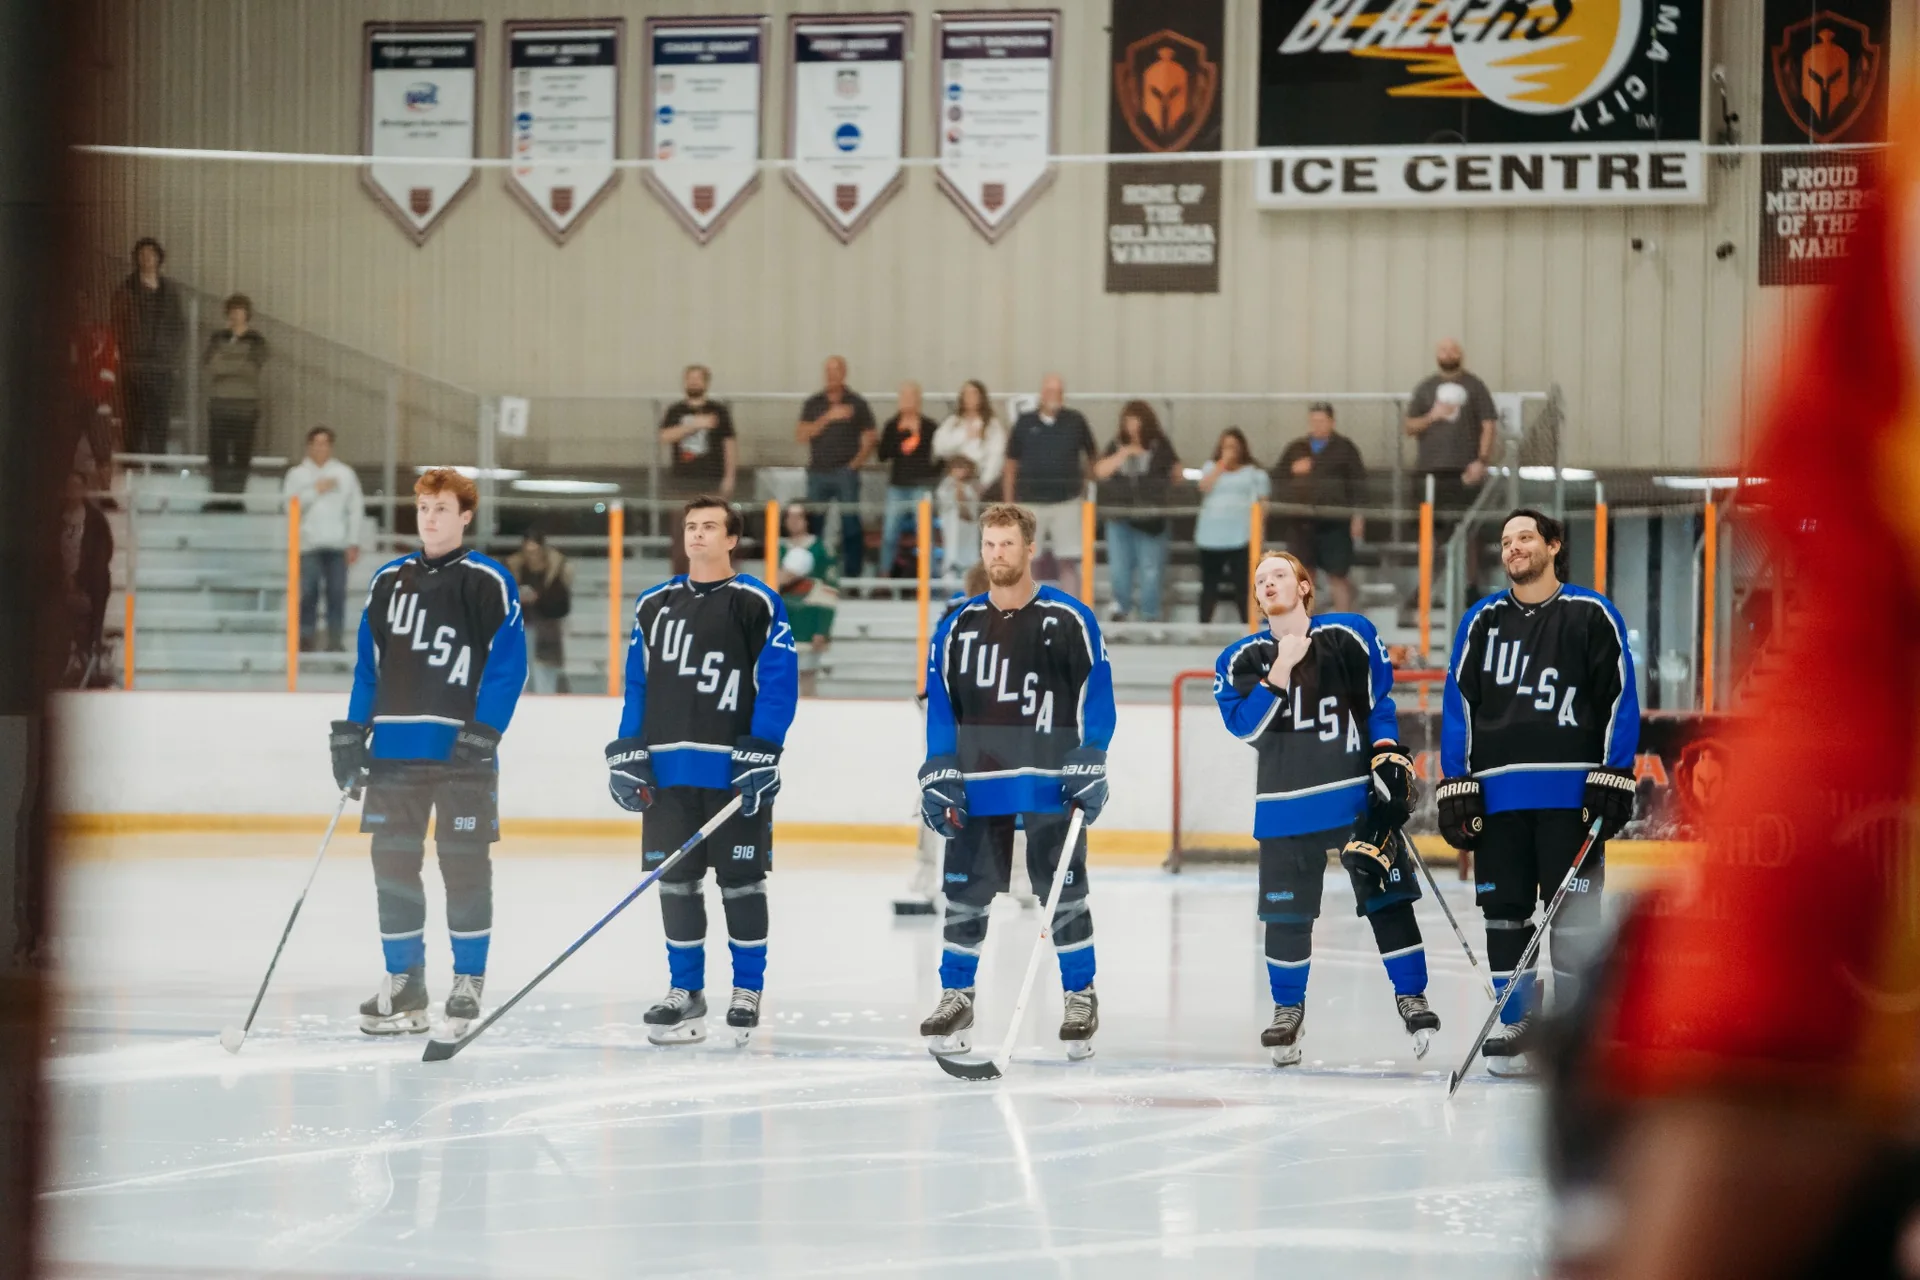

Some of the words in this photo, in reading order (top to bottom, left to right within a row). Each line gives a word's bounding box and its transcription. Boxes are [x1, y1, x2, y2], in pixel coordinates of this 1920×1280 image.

[1270, 156, 1378, 194] ICE
[1404, 153, 1688, 192] CENTRE
[1780, 166, 1859, 189] PROUD
[1765, 189, 1876, 214] MEMBER
[1777, 215, 1807, 237] OF
[1813, 213, 1859, 235] THE
[1788, 237, 1850, 260] NAHL
[958, 631, 1054, 734] TULSA
[1483, 627, 1579, 727] TULSA
[731, 750, 776, 764] AUER
[1436, 781, 1480, 803] ARRIOR
[1585, 771, 1637, 793] WARRIO
[454, 816, 477, 830] 918
[732, 845, 756, 860] 918
